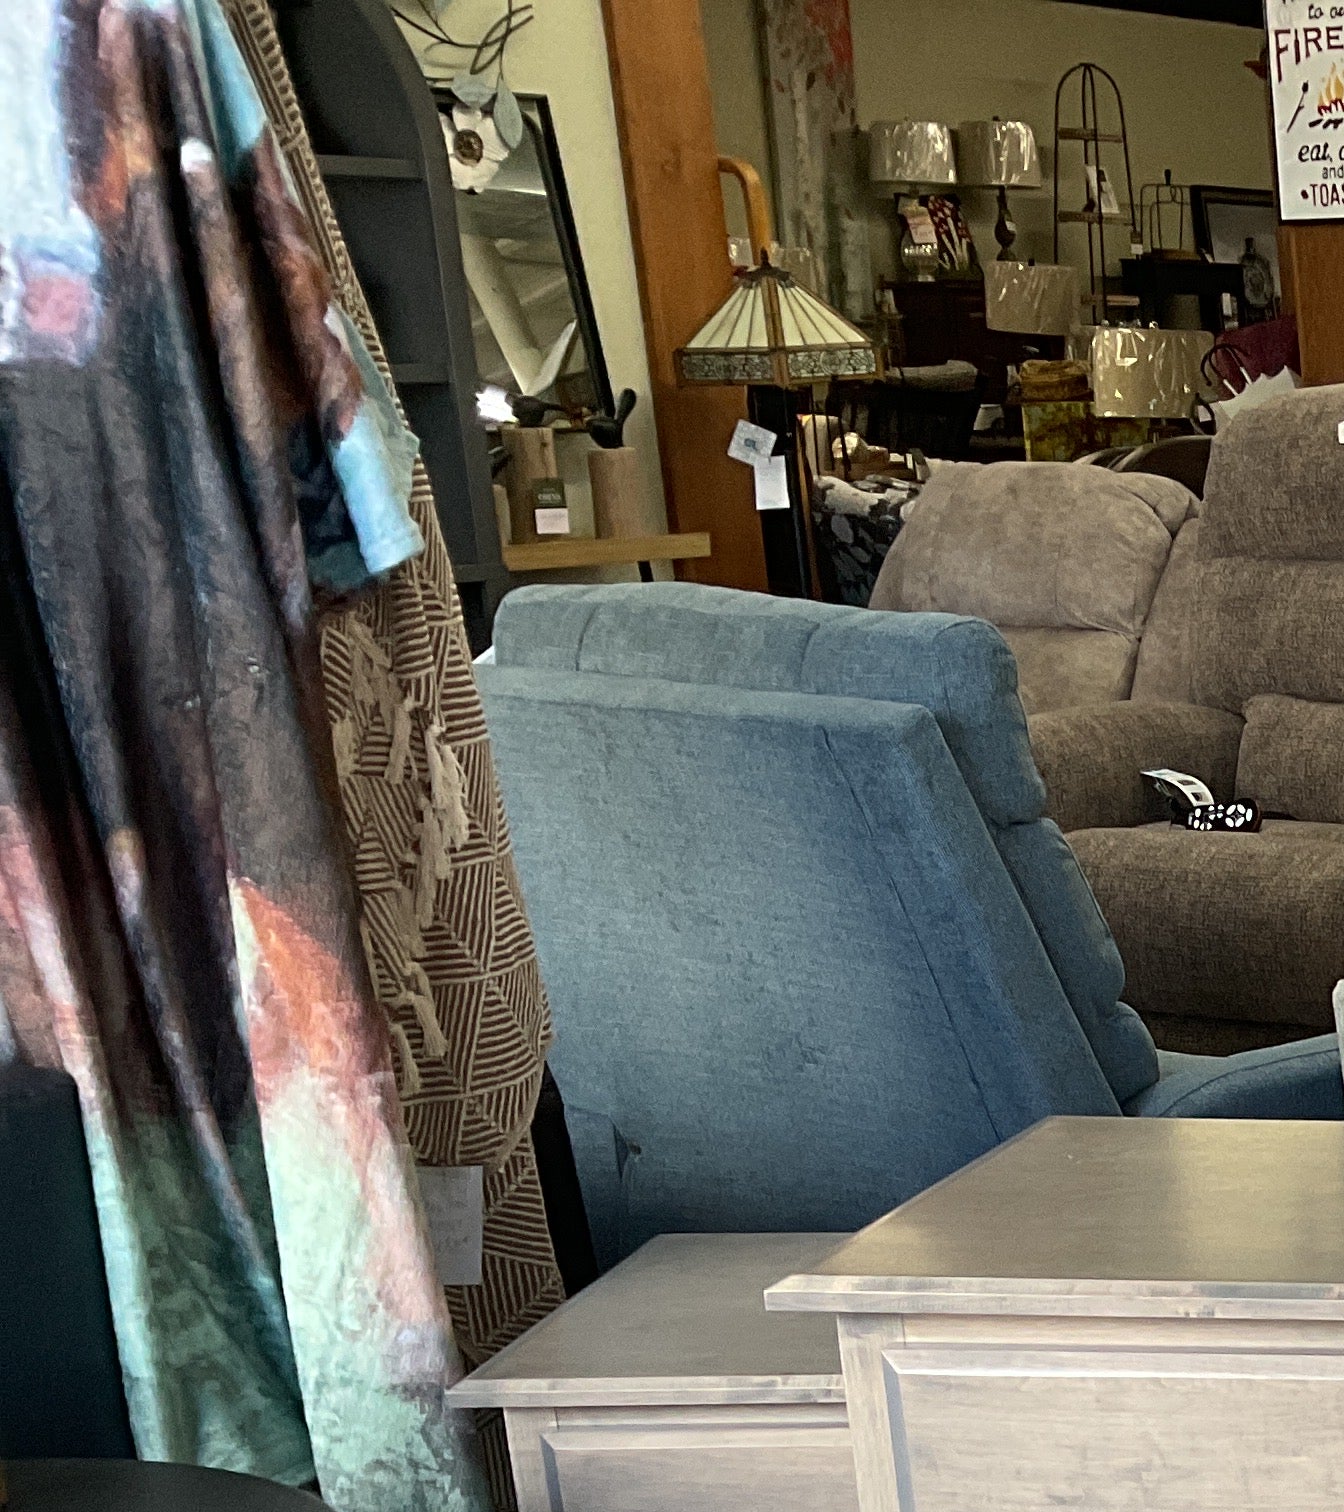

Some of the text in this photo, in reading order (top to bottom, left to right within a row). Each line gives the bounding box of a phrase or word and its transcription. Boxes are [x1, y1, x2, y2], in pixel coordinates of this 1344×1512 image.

[1308, 4, 1324, 20] to
[1298, 142, 1334, 163] eat,
[1322, 165, 1344, 179] and
